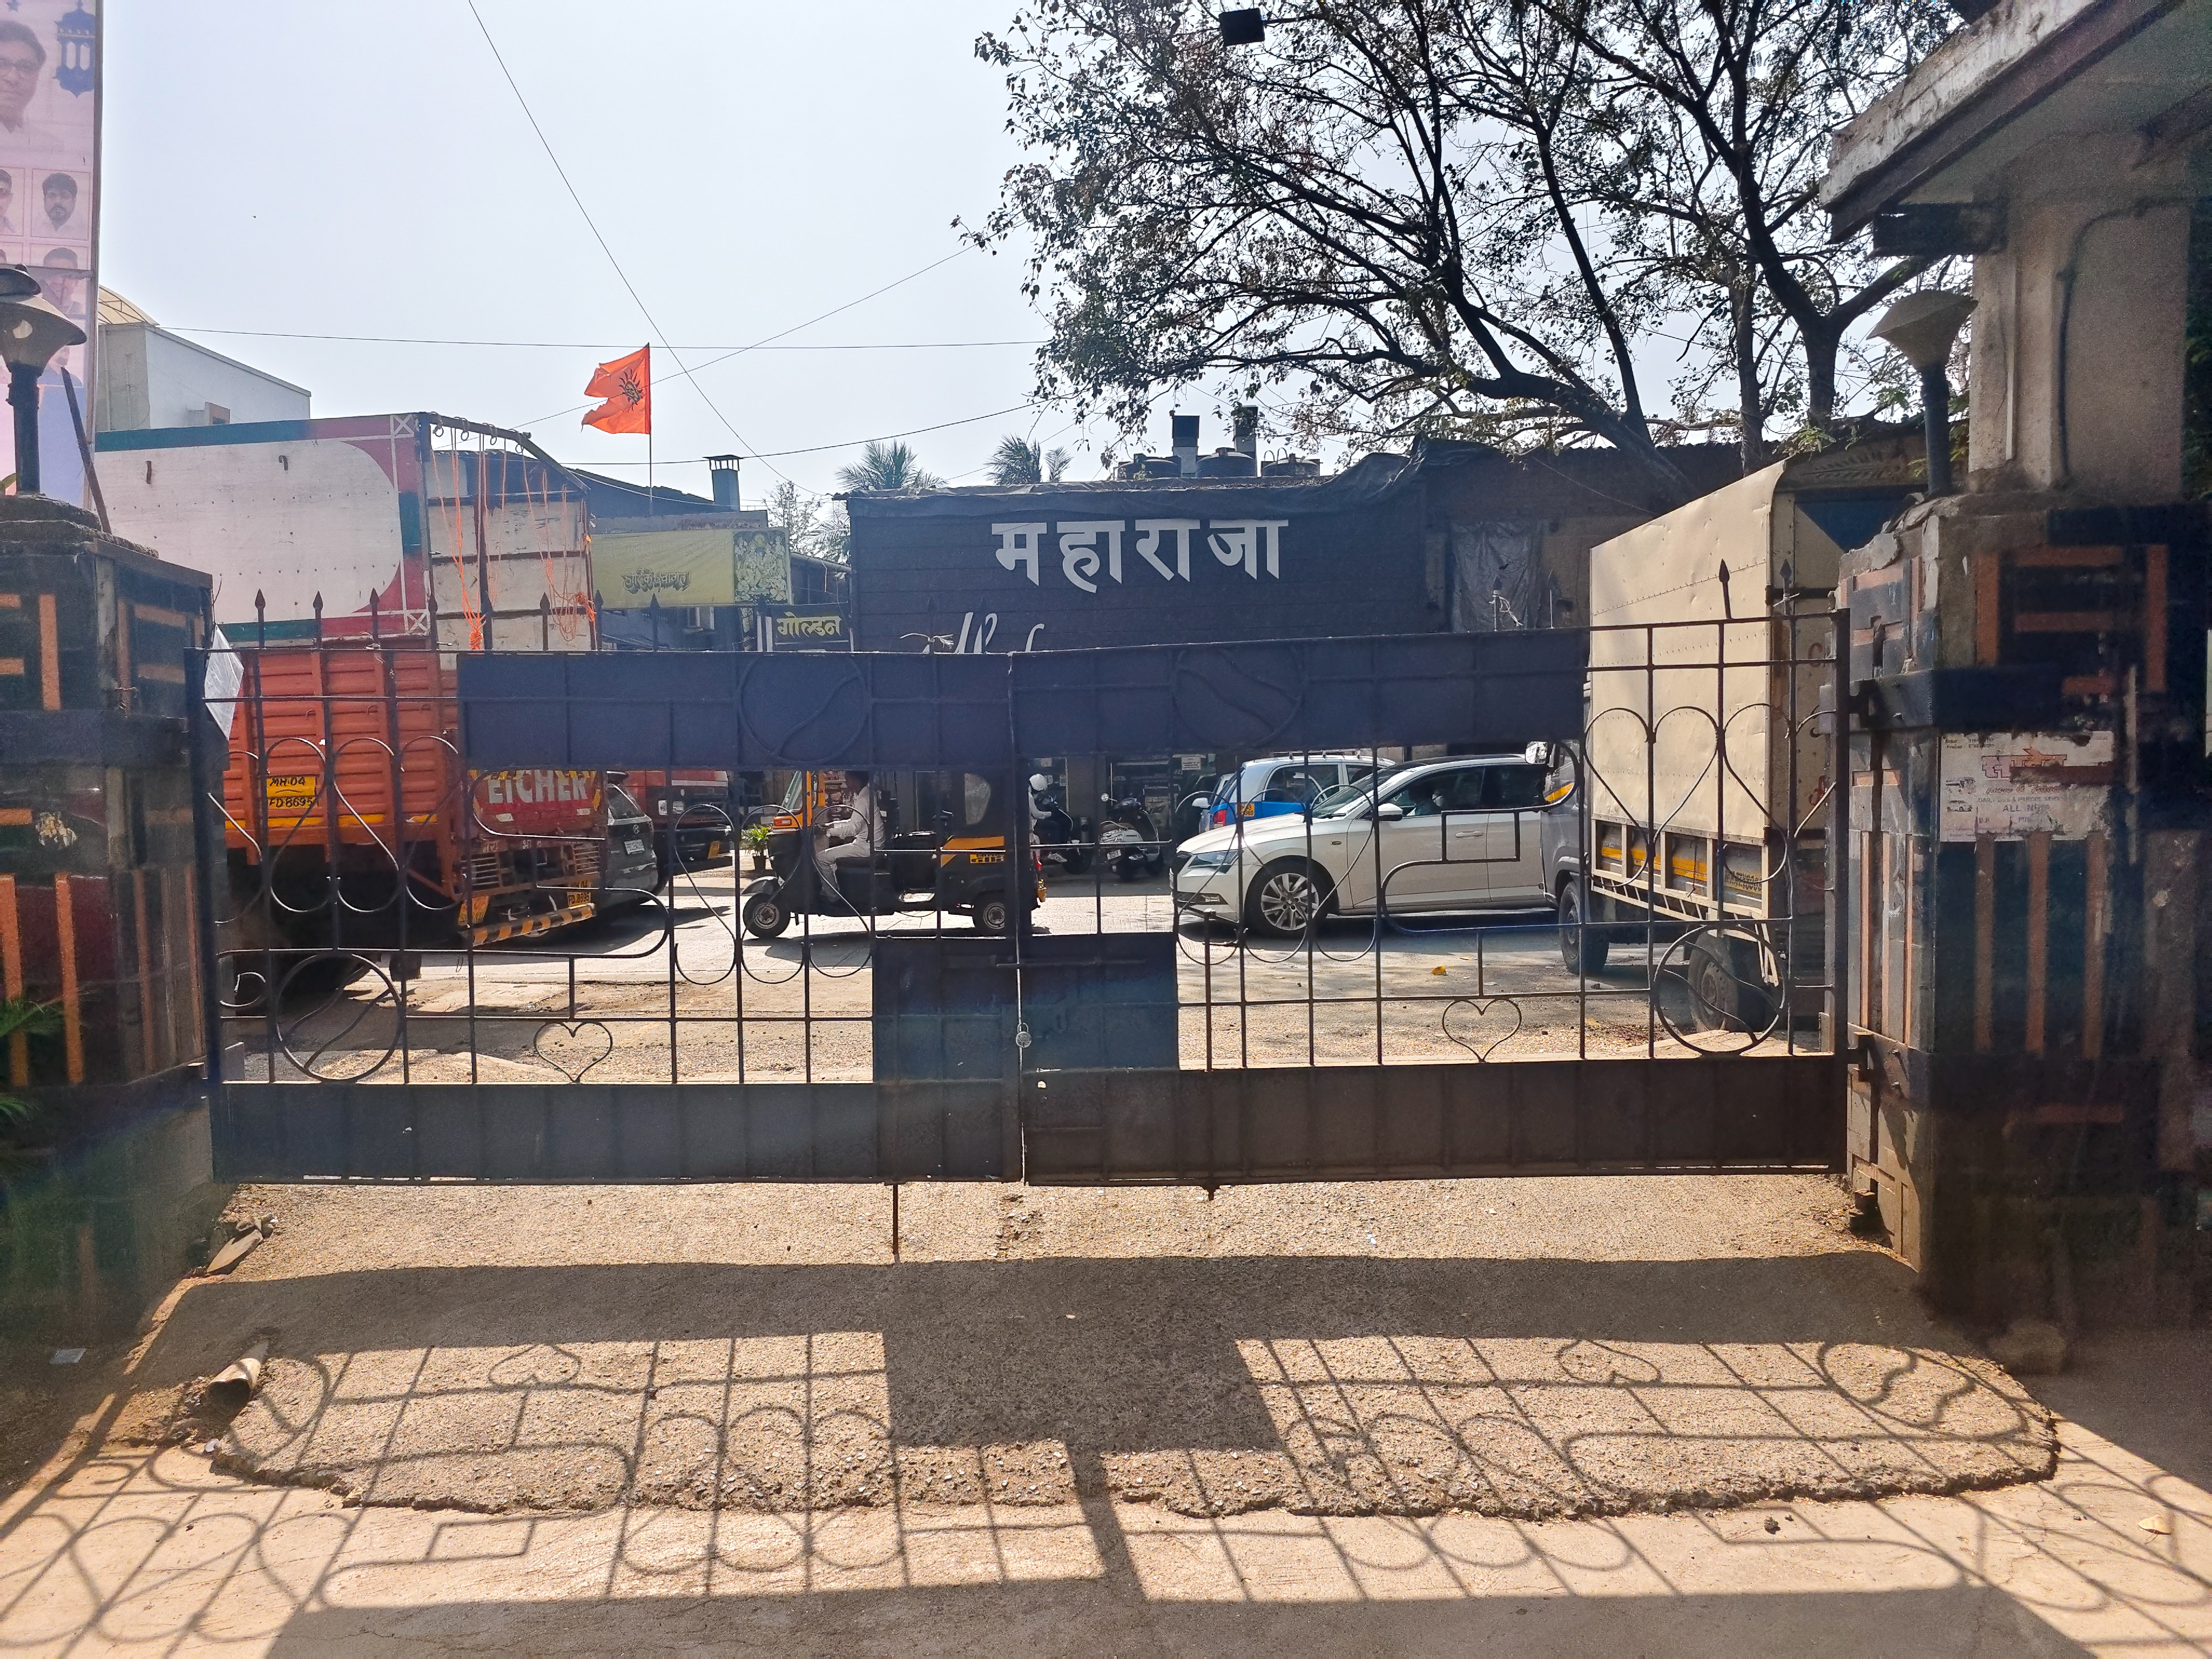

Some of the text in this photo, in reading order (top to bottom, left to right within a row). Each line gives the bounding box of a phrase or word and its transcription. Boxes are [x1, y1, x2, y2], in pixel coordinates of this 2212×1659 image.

[992, 519, 1289, 594] महाराजा
[776, 611, 842, 638] गोल्डन
[488, 770, 589, 804] EICHER
